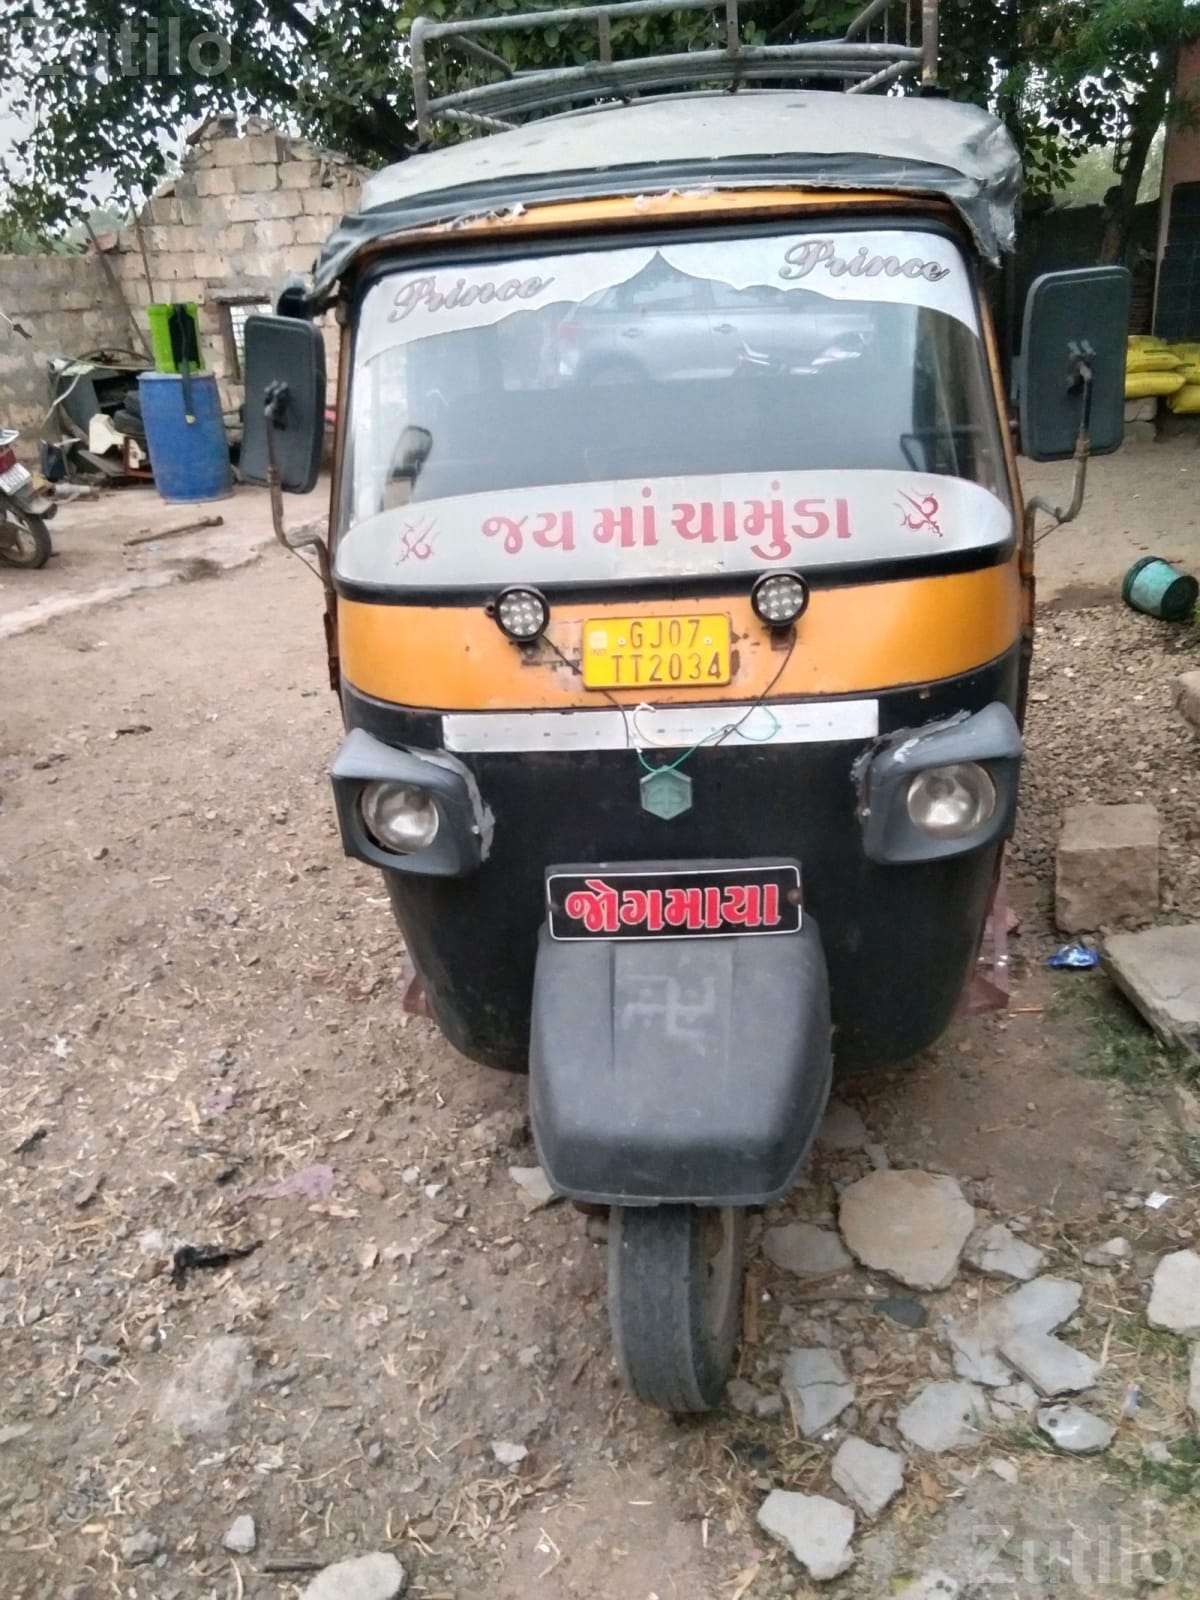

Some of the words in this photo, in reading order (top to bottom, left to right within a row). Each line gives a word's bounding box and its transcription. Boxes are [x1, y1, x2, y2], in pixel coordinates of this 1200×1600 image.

[777, 239, 950, 282] Prince
[387, 274, 555, 323] Prince
[481, 510, 576, 554] જય
[592, 486, 659, 547] માં
[630, 618, 701, 649] GJ07
[611, 651, 722, 684] TT2034
[565, 879, 782, 932] જોગમાયા
